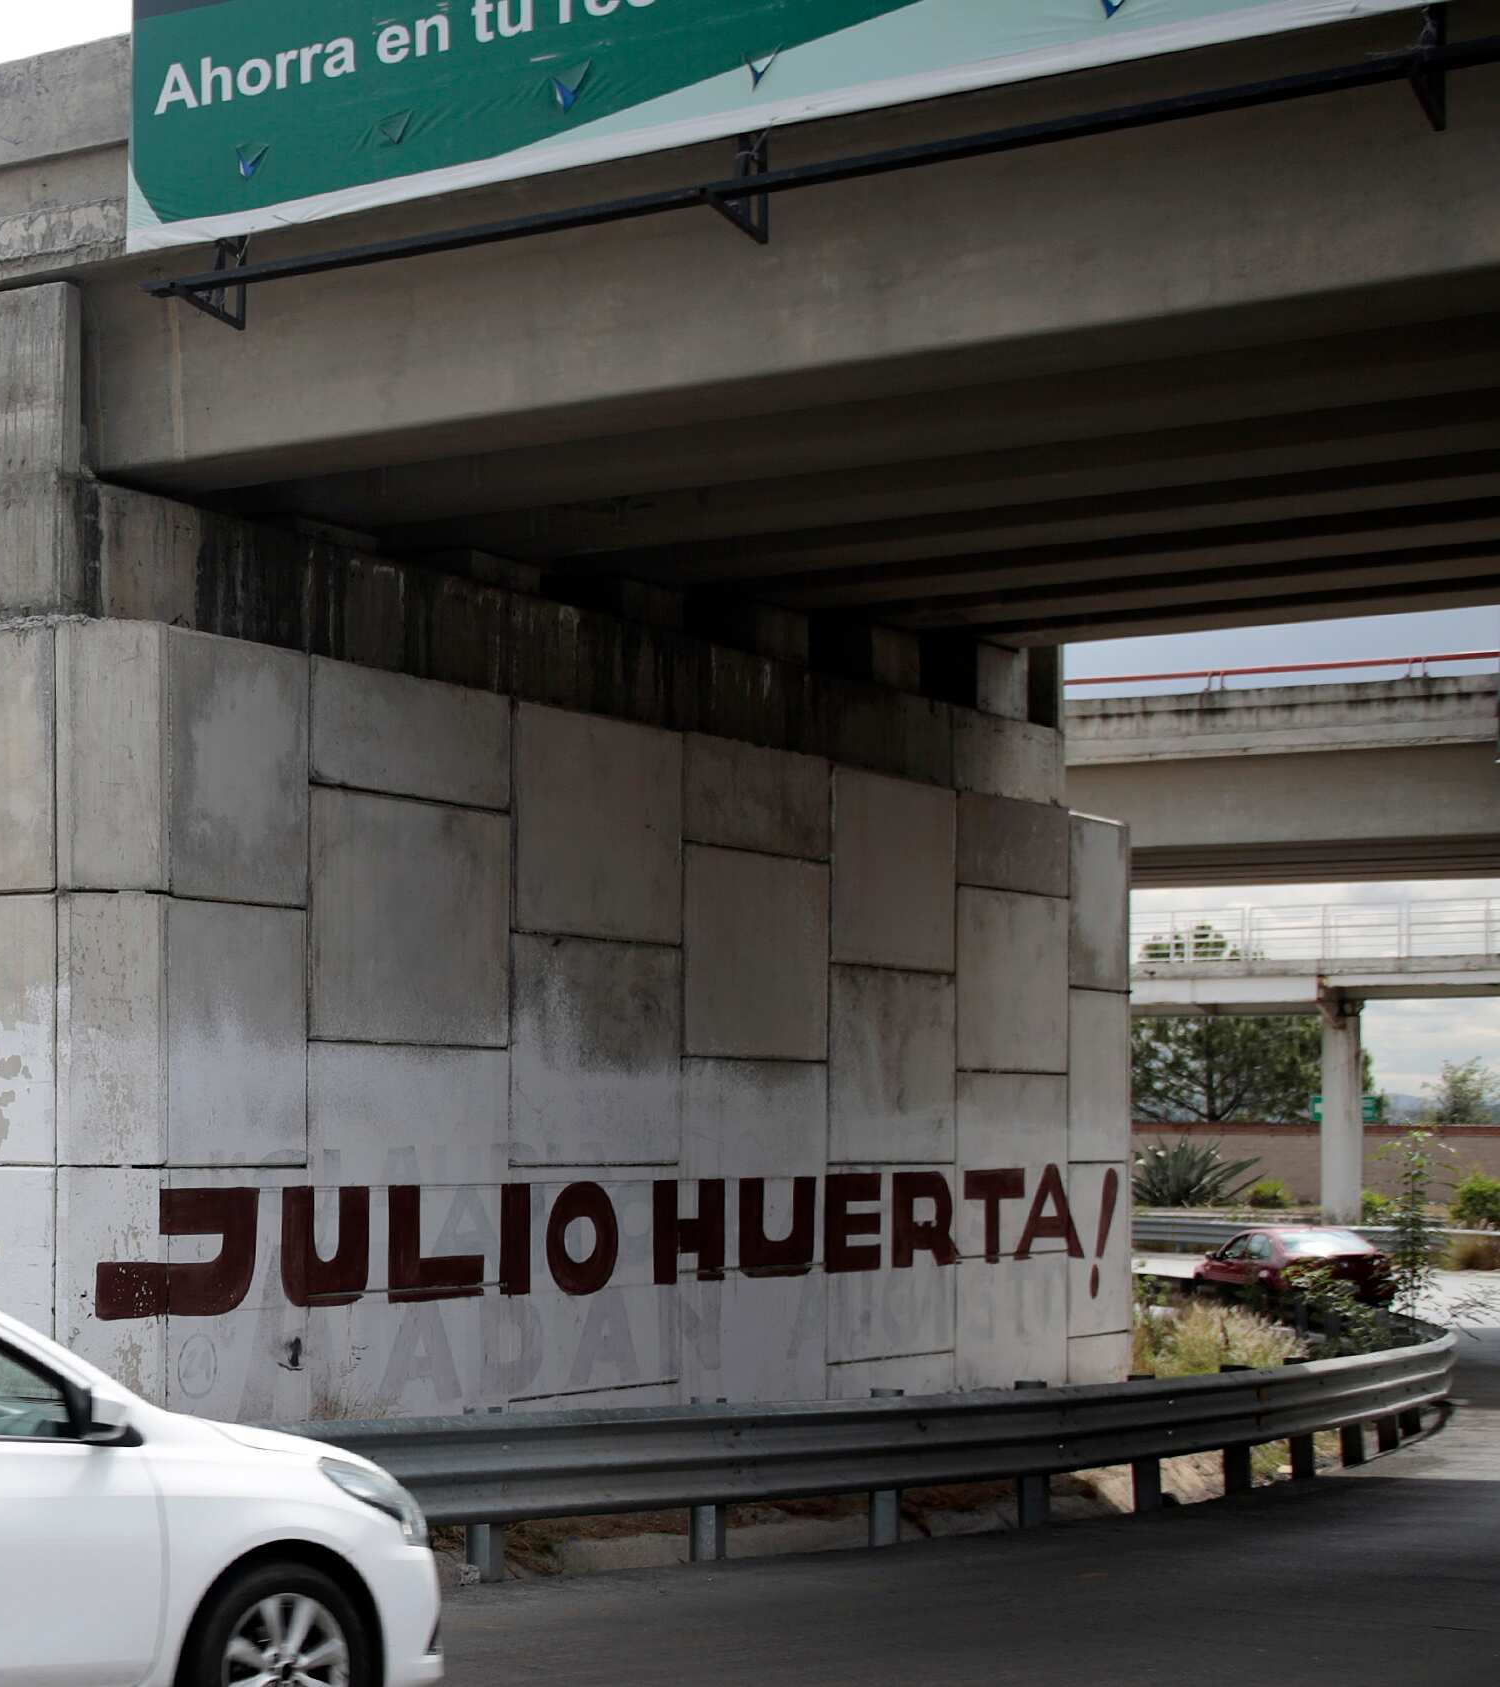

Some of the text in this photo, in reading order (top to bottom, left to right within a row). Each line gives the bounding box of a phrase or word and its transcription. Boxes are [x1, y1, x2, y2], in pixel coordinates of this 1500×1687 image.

[155, 36, 355, 115] Ahorra
[376, 13, 450, 64] en
[471, 0, 533, 43] tu
[95, 1163, 1119, 1321] JULIO HUERTA!
